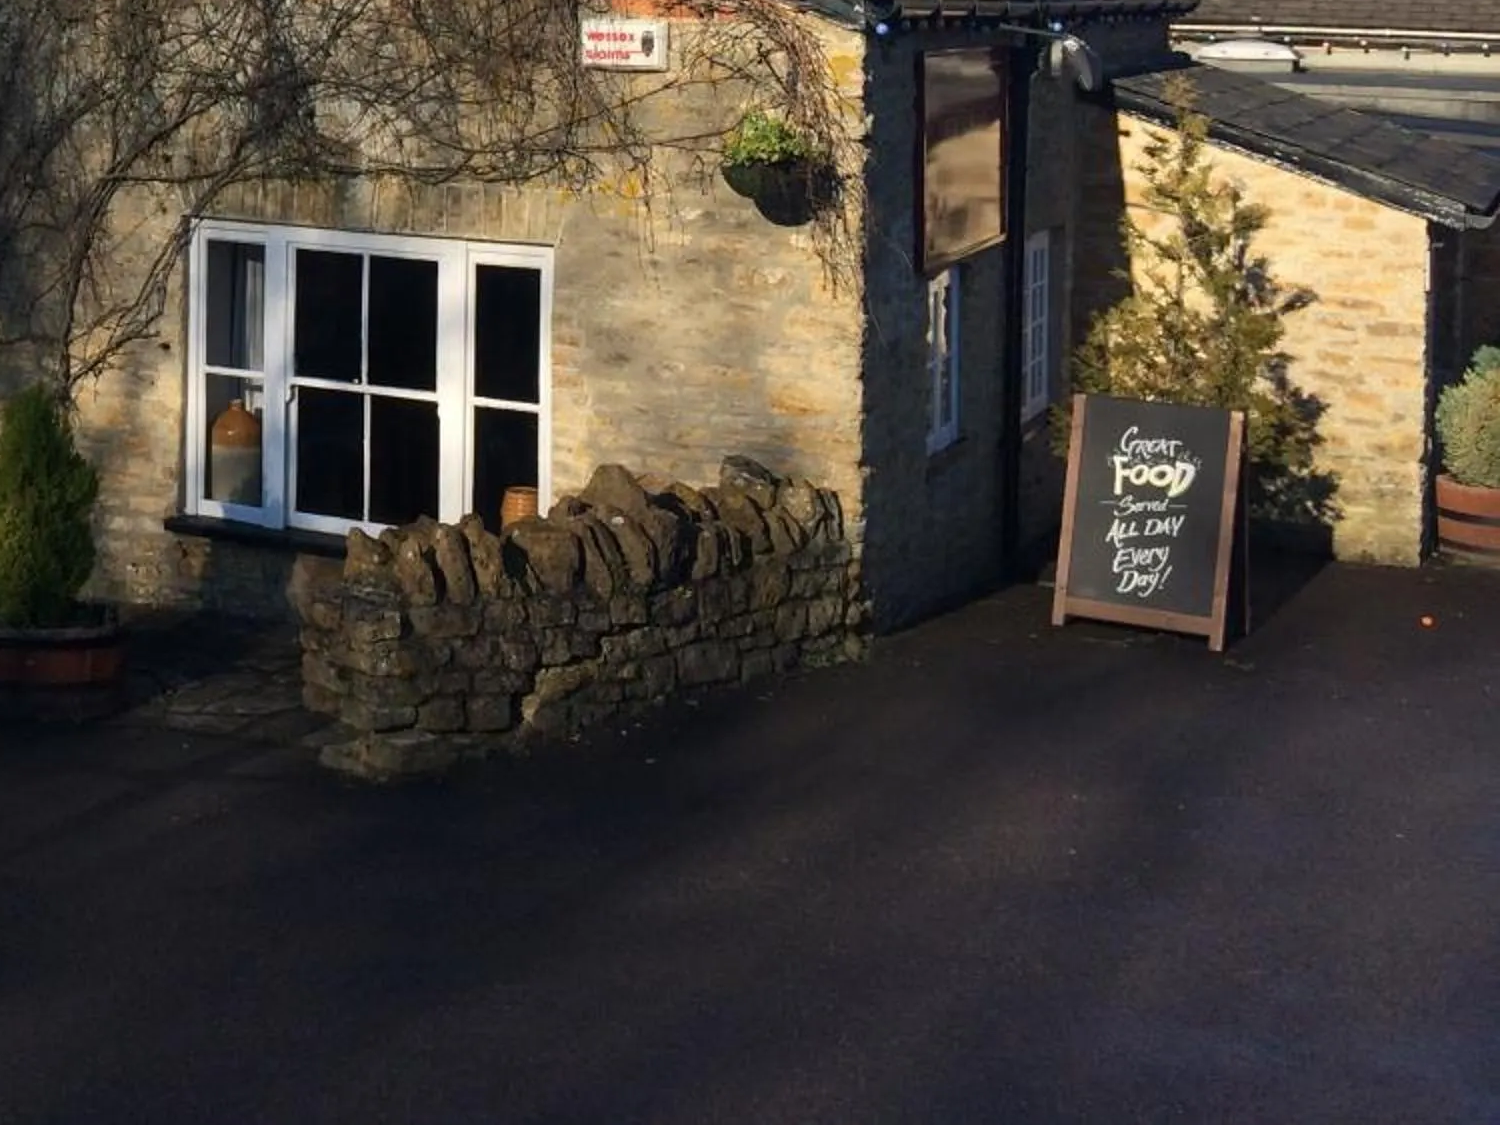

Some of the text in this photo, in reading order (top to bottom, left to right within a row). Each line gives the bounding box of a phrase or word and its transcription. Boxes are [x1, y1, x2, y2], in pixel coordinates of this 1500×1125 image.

[1113, 456, 1197, 498] FOOD
[1113, 494, 1169, 516] Served
[1105, 515, 1186, 548] ALL DAY
[1116, 565, 1173, 598] Day!
